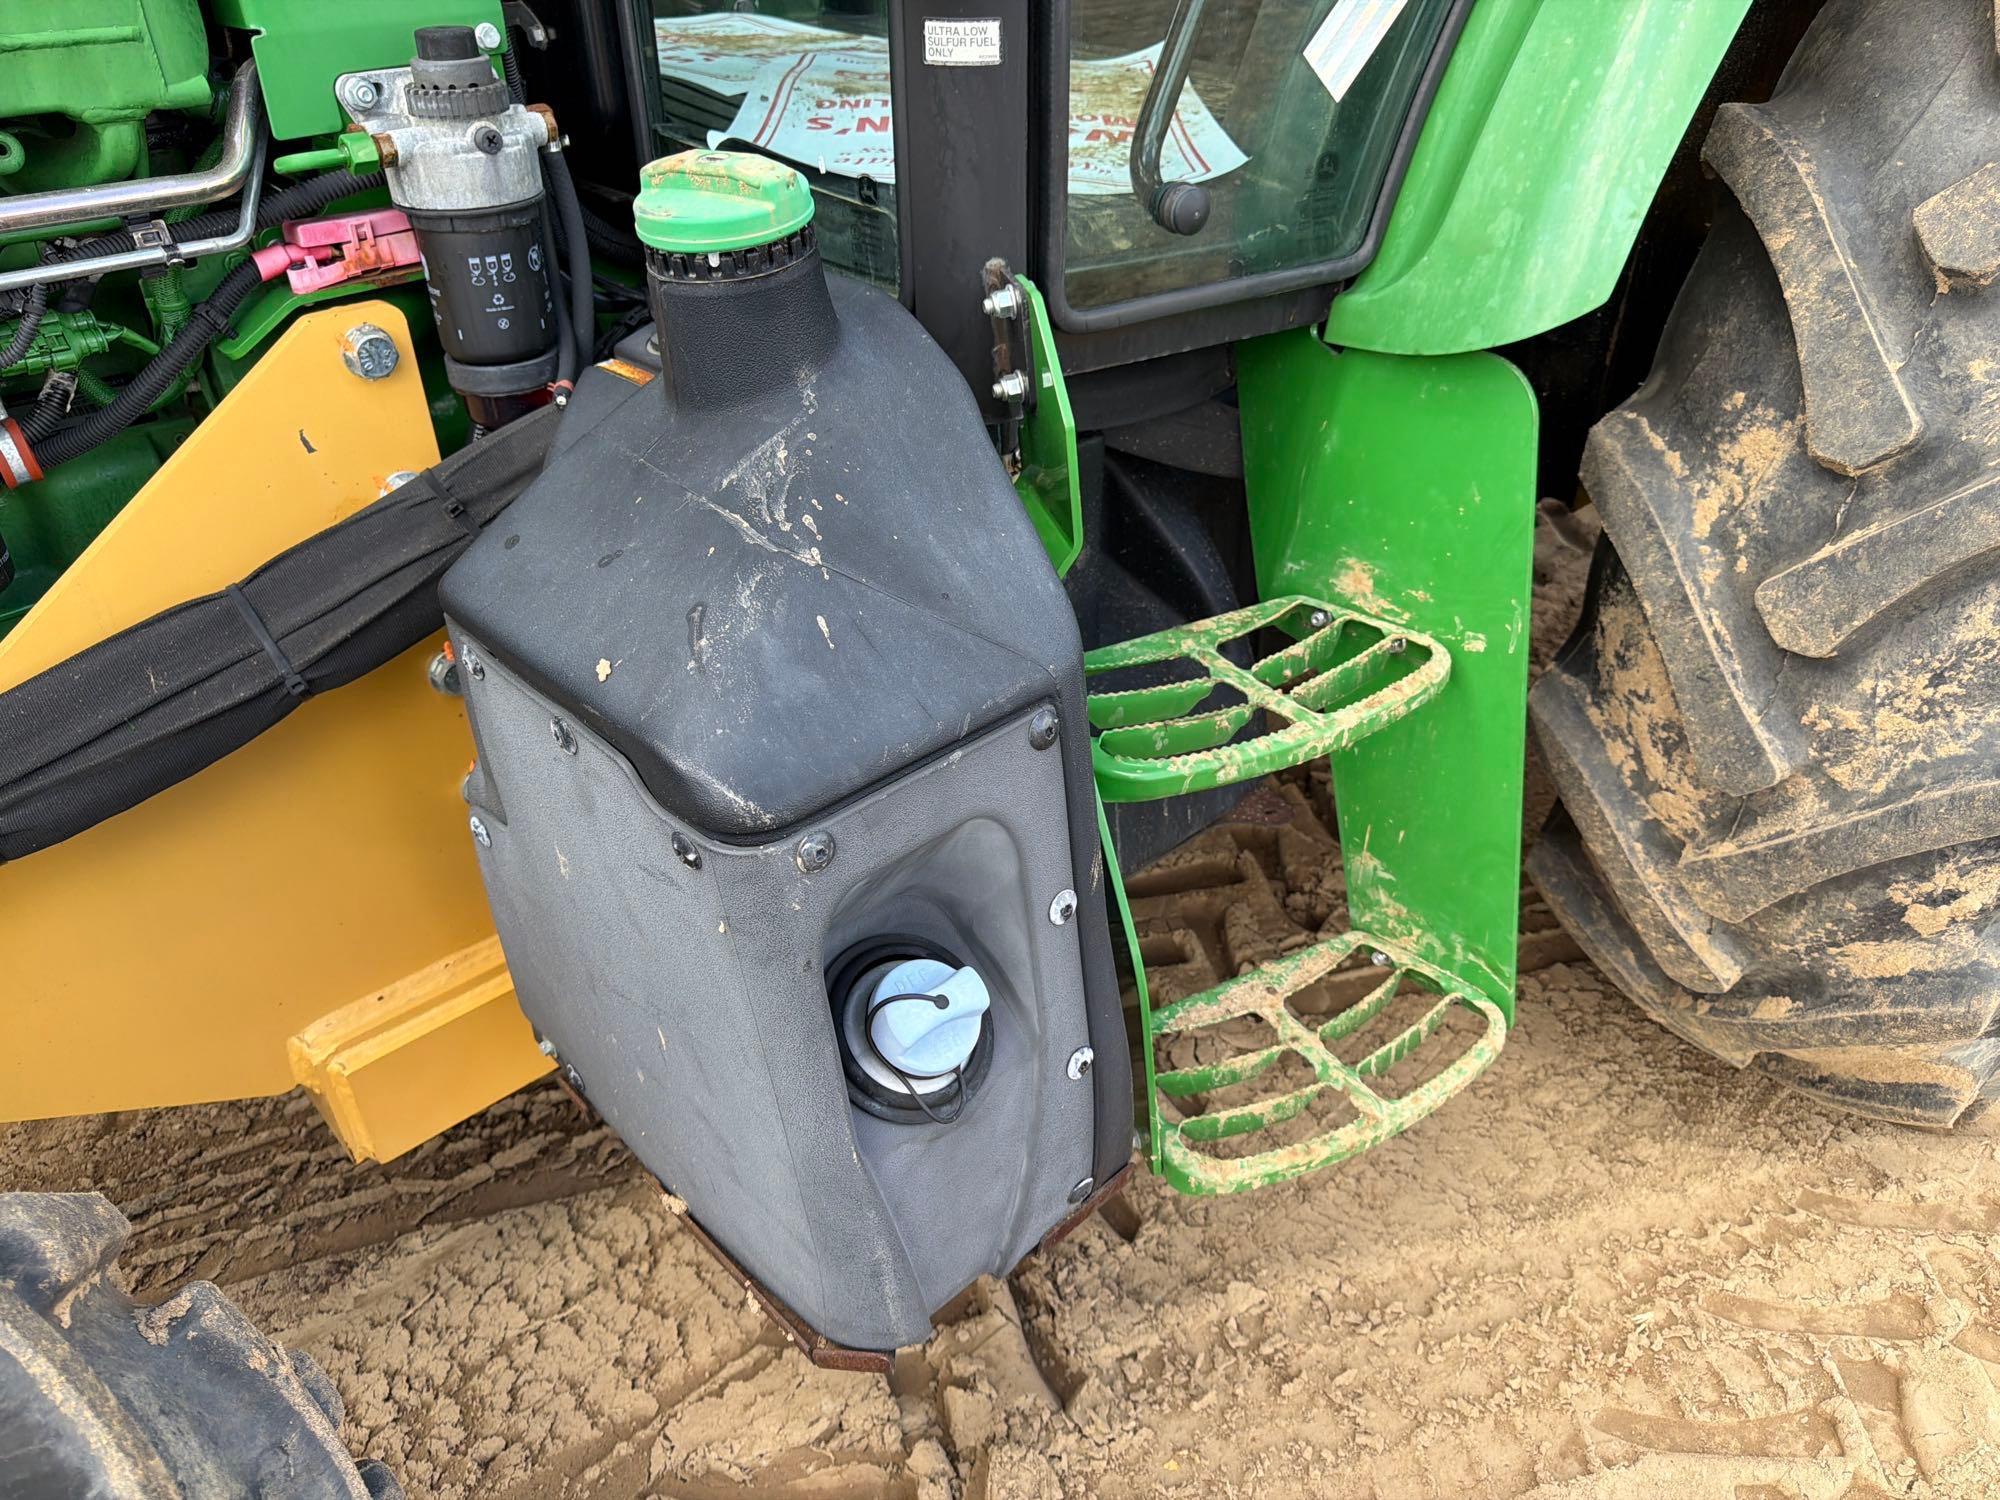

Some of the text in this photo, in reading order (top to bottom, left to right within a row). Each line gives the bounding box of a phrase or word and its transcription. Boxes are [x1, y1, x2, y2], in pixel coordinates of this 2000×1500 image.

[928, 26, 988, 36] ULTRA LOW
[927, 36, 996, 47] SULFUR FUEL
[928, 47, 954, 57] ONLY
